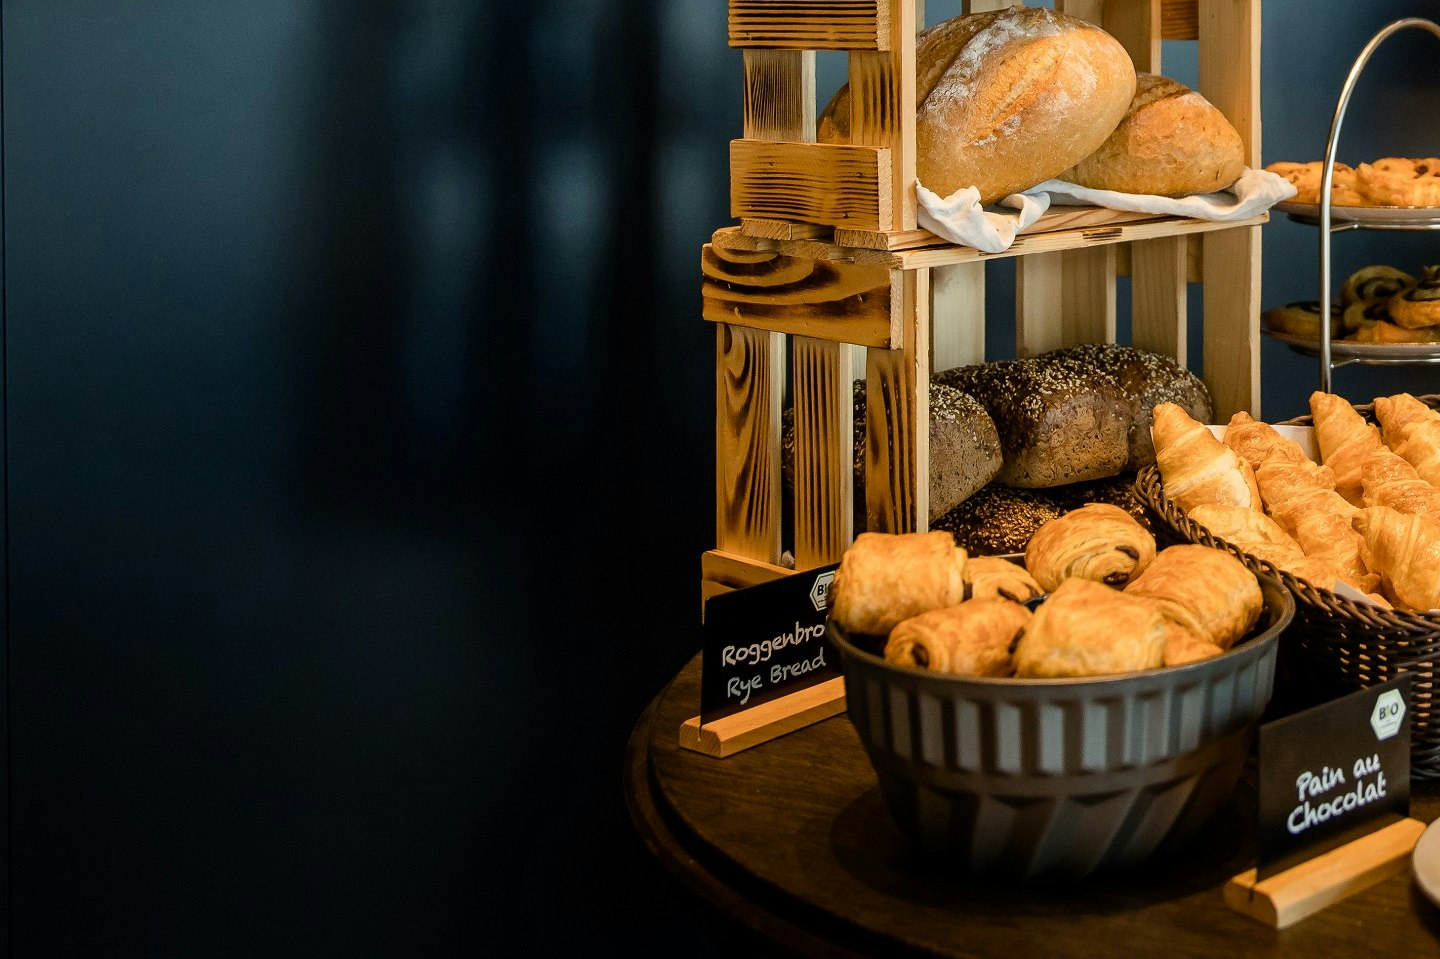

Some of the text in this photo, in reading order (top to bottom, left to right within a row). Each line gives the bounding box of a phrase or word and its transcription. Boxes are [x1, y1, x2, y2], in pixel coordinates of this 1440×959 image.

[722, 615, 828, 667] Roggenbro
[727, 647, 827, 705] Rye Bread
[1287, 771, 1387, 834] Chocolat
[1296, 753, 1381, 802] Pain au
